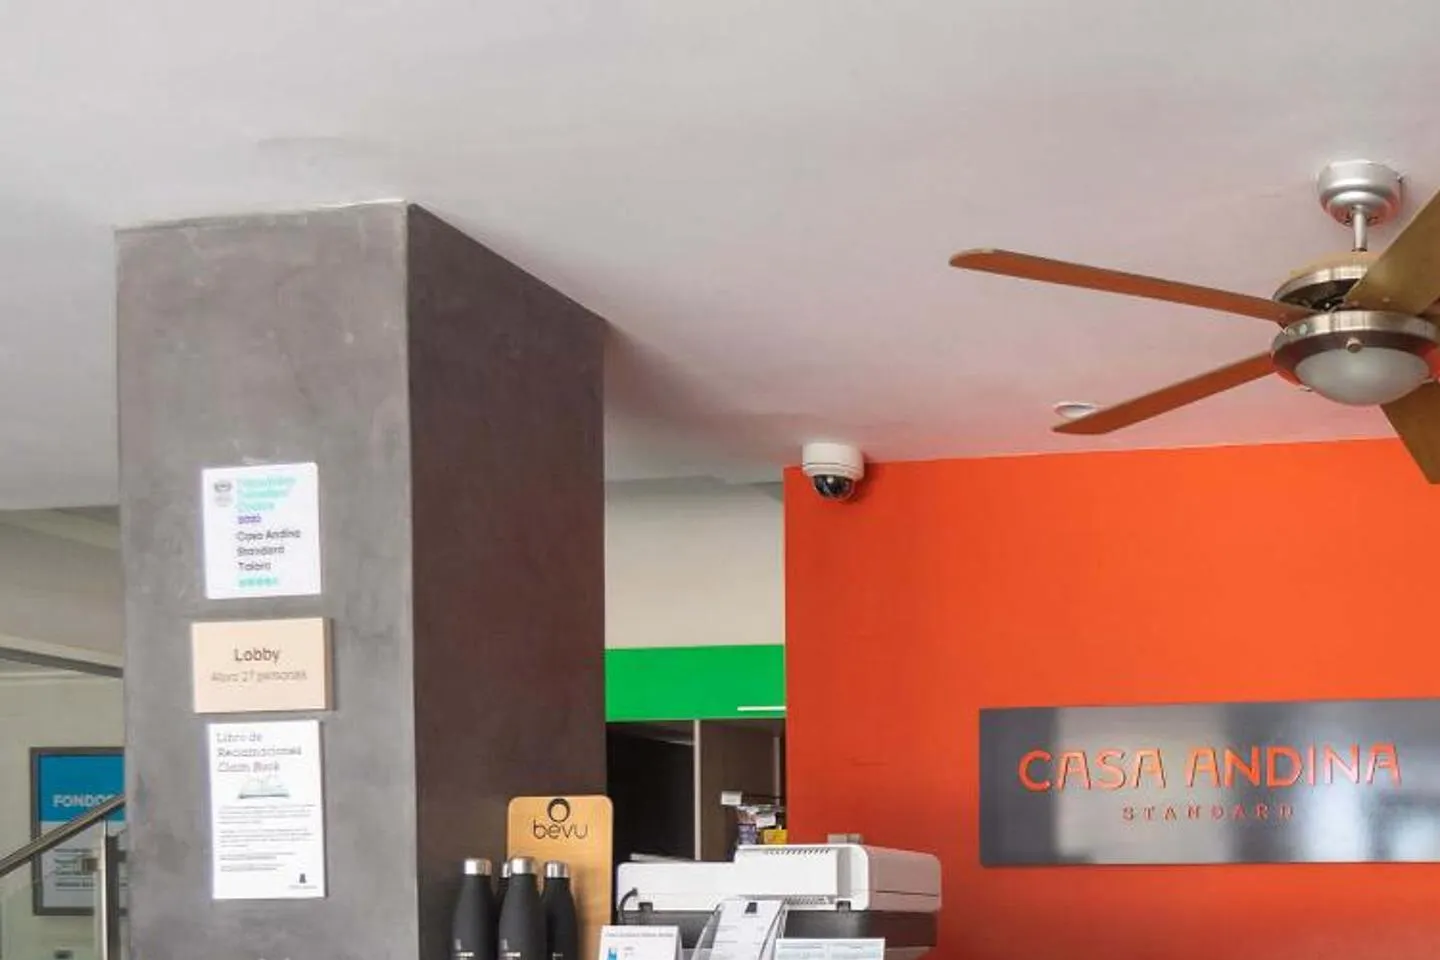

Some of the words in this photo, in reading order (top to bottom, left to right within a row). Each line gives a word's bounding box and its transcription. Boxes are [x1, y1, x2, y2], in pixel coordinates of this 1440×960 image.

[234, 646, 280, 667] Lobby
[1016, 748, 1168, 792] CASA
[1185, 742, 1402, 790] ANDINA
[1122, 804, 1296, 822] STANDARD
[532, 820, 589, 841] bevu
